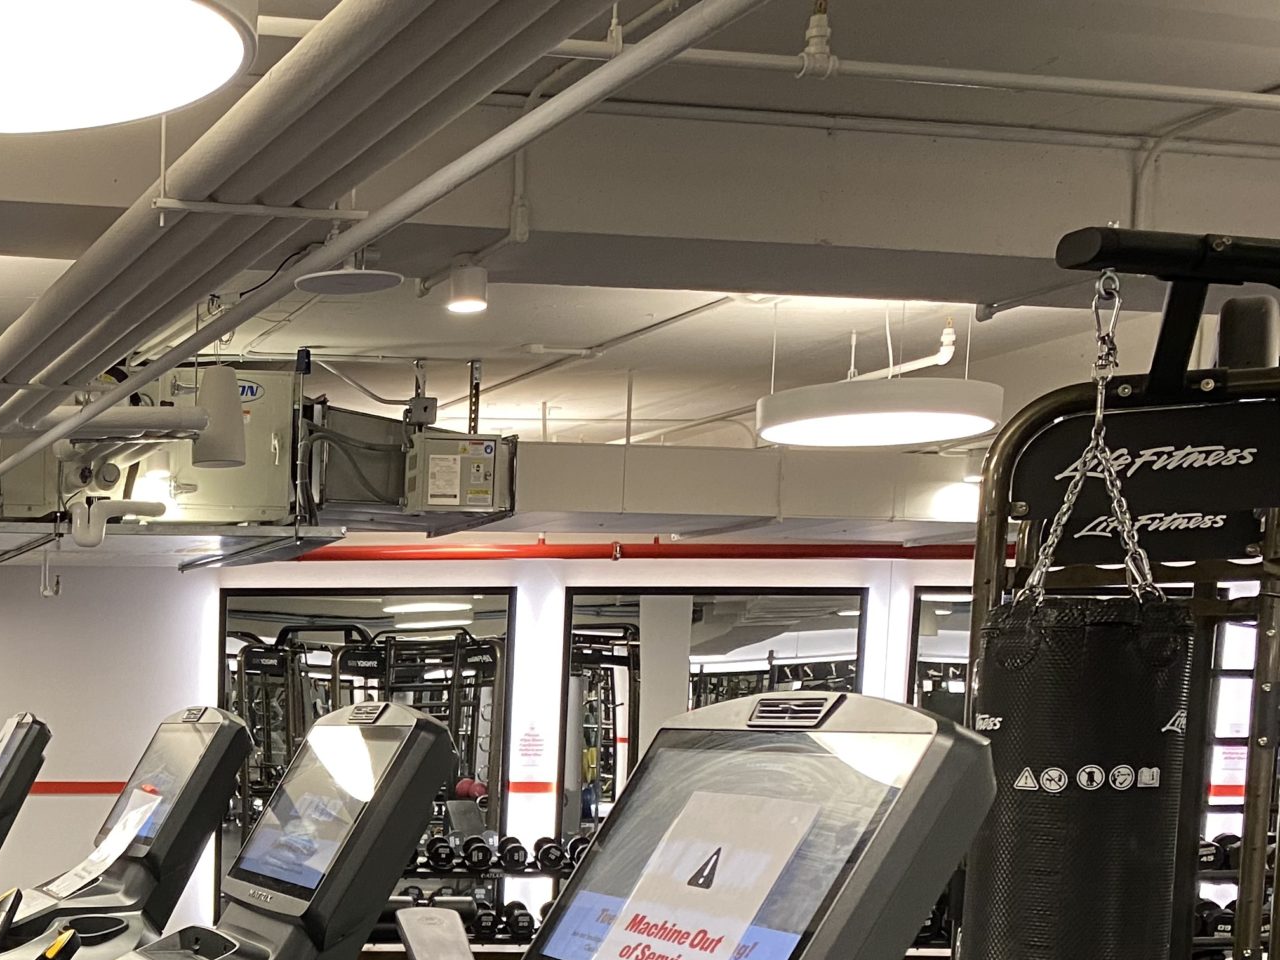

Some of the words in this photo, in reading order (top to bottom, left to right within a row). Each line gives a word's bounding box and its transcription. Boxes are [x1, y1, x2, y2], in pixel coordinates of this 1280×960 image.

[1126, 445, 1258, 477] Fitness
[1073, 515, 1124, 538] Lif
[1132, 512, 1227, 532] Fitness
[624, 913, 691, 945] Machine
[689, 929, 725, 953] Out
[619, 942, 643, 960] of
